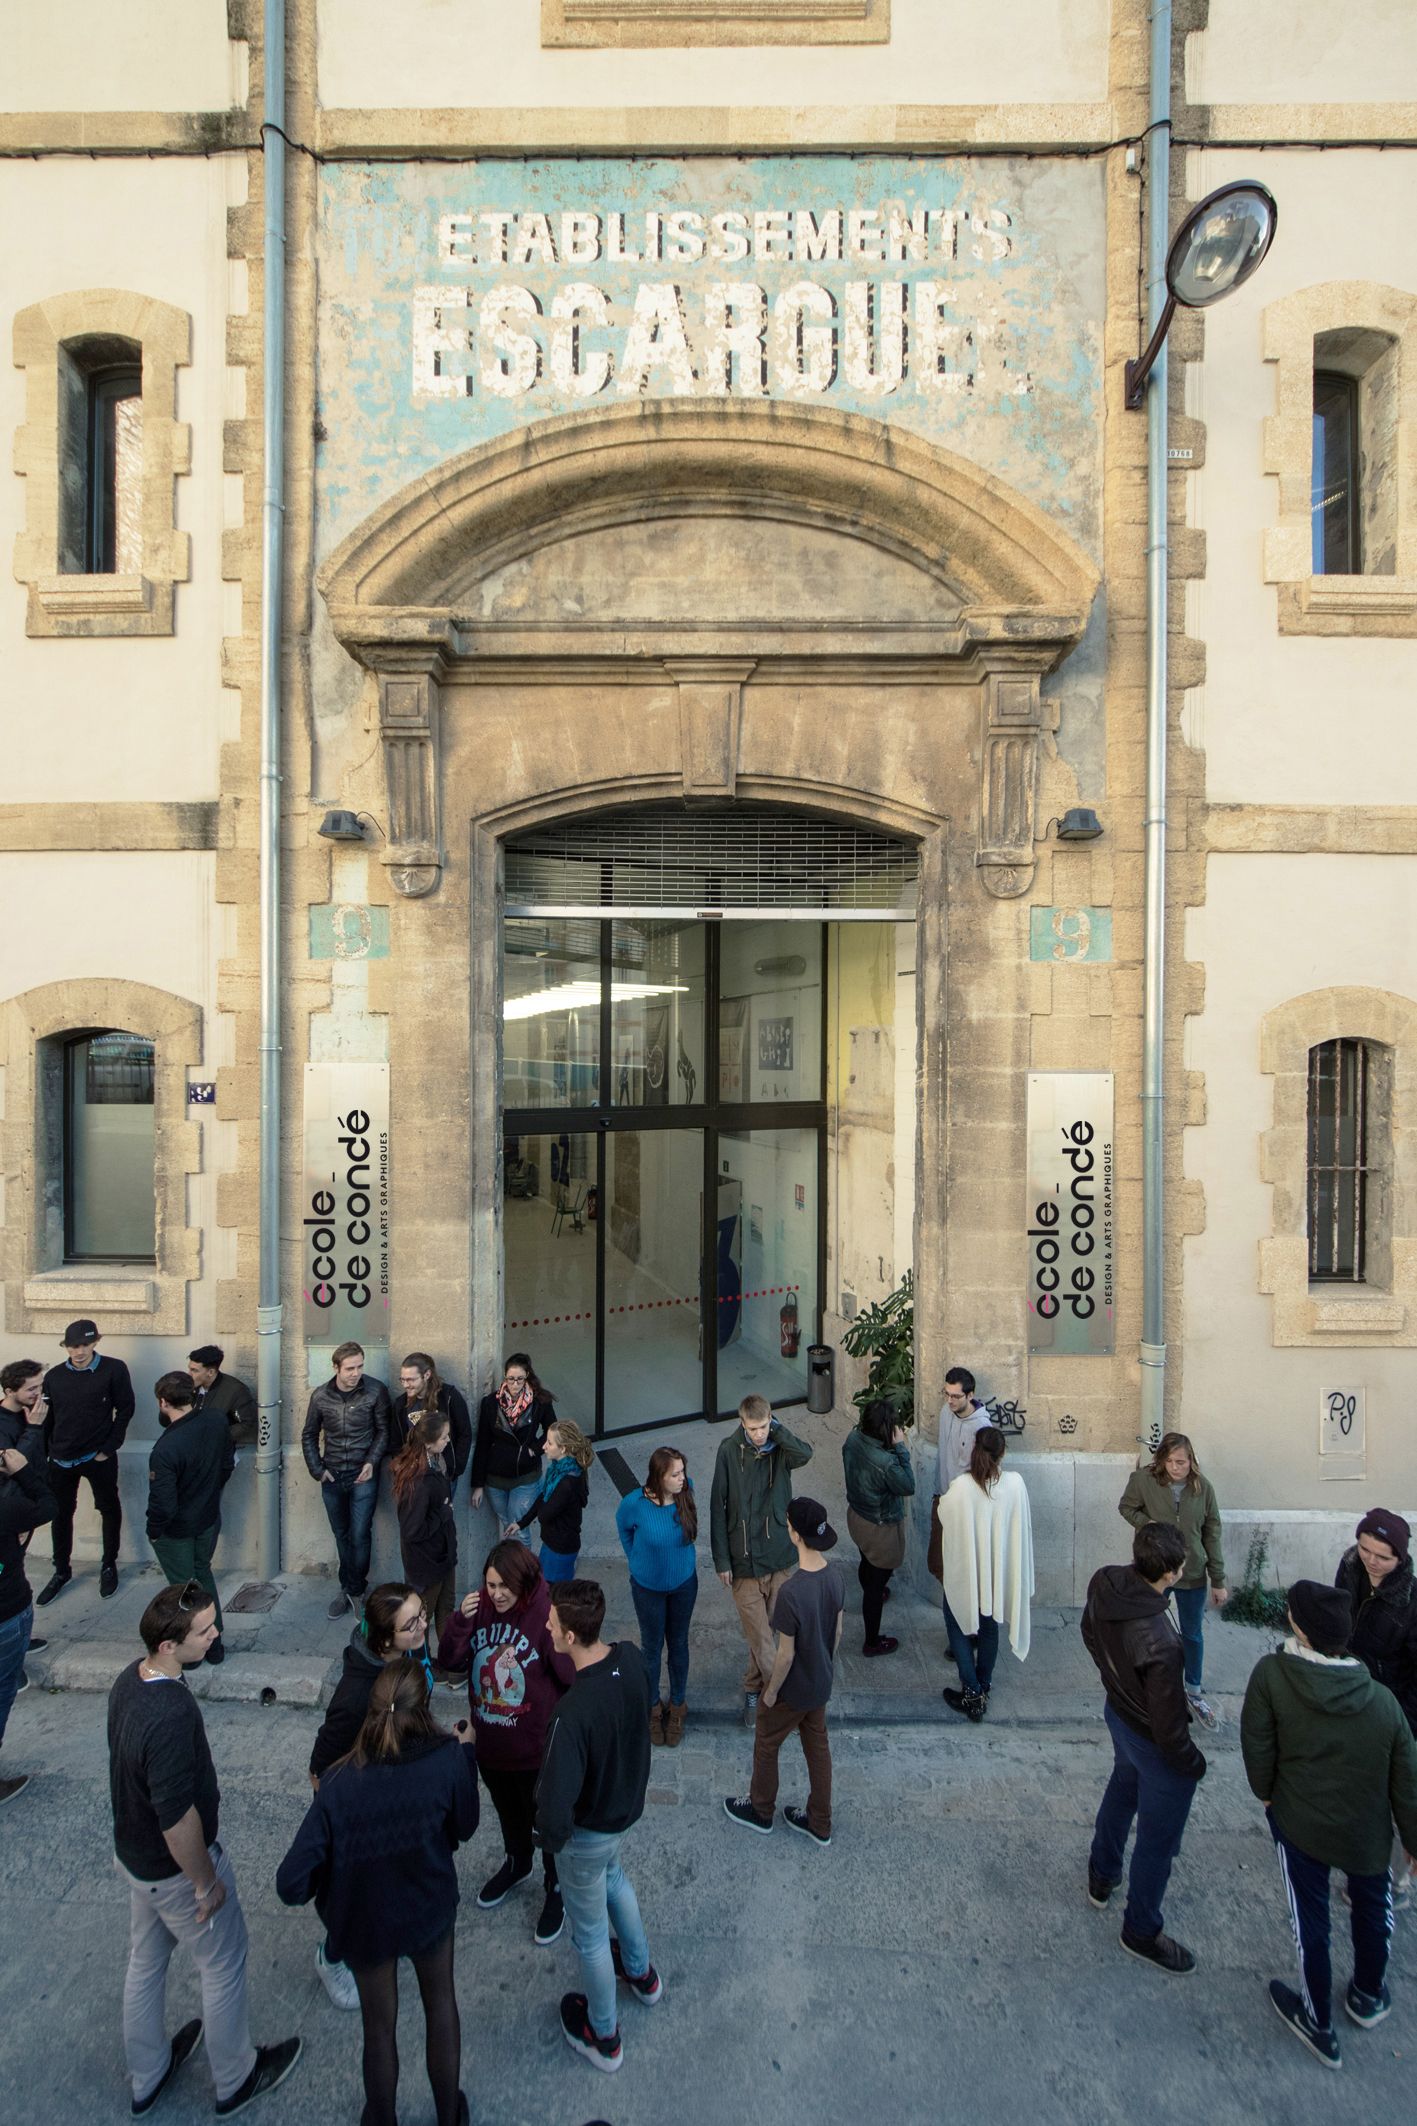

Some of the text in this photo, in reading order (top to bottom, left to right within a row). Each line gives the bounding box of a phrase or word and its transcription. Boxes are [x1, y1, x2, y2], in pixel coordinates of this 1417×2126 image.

[438, 210, 1012, 264] ETABLISSEMENTS
[411, 280, 1035, 398] ESCARGUE
[332, 904, 372, 961] 9
[1051, 907, 1091, 962] 9
[337, 1109, 371, 1309] de condé
[379, 1132, 389, 1294] DESIGN & ARTS GRAPHIQUES
[1061, 1120, 1095, 1320] de condé
[1103, 1143, 1112, 1305] DESIGN & ARTS GRAPHIQUES
